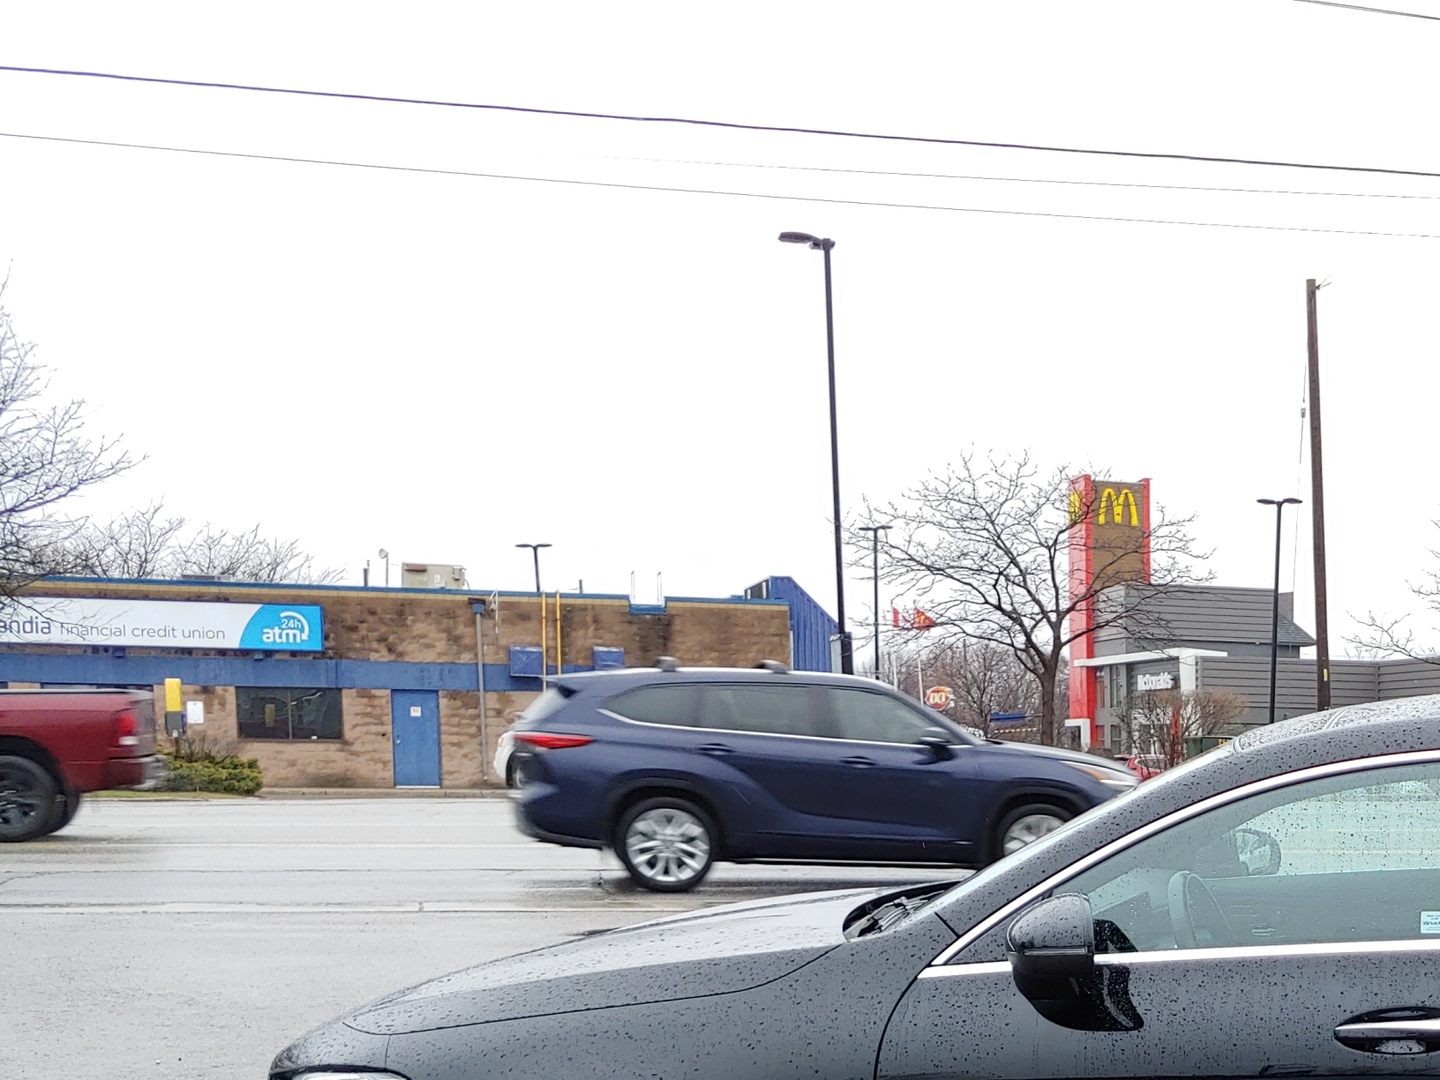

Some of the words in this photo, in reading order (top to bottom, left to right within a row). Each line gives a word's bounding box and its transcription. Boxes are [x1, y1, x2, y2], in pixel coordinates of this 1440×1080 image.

[281, 618, 302, 629] 24h
[131, 624, 178, 639] credit
[182, 626, 226, 640] union
[262, 627, 302, 643] atm
